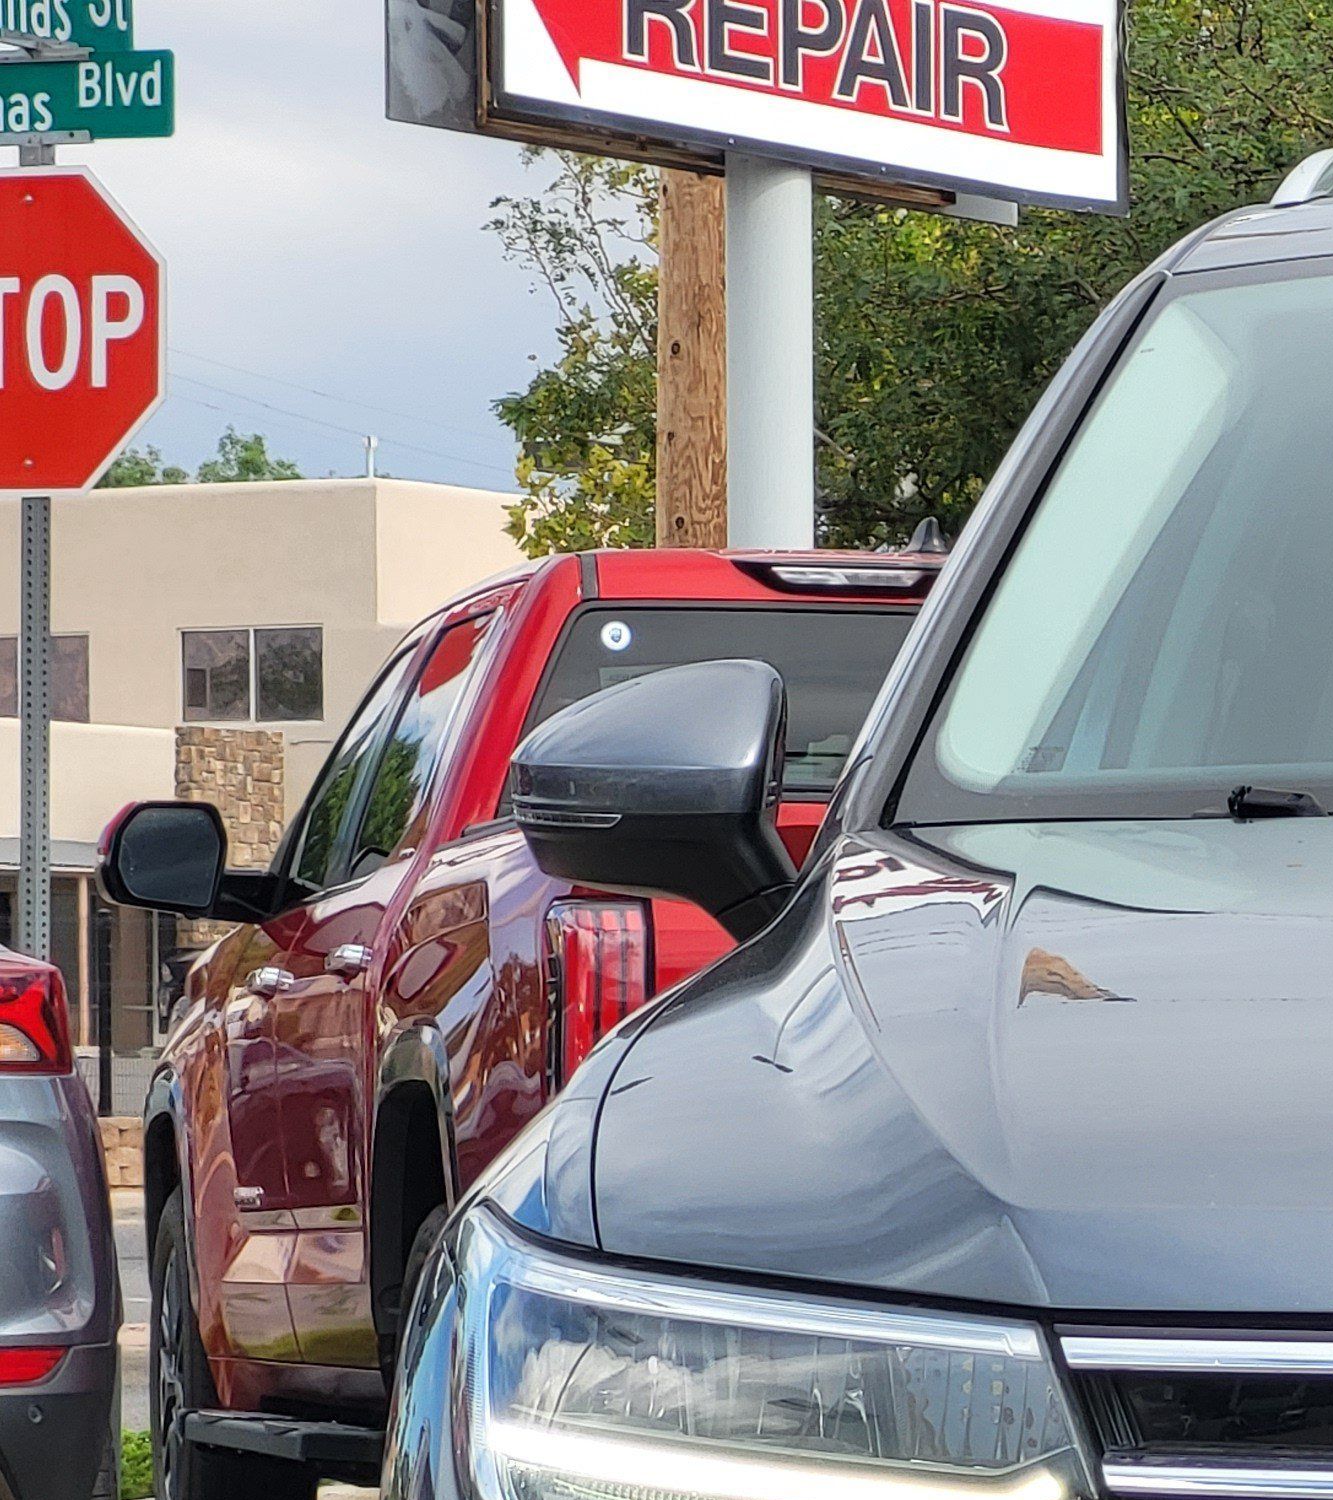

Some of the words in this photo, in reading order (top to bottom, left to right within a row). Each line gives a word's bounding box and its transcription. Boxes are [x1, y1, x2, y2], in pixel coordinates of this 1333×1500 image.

[0, 92, 54, 132] as
[78, 60, 162, 108] Blvd
[622, 0, 1010, 133] REPAIR
[0, 274, 145, 391] OP
